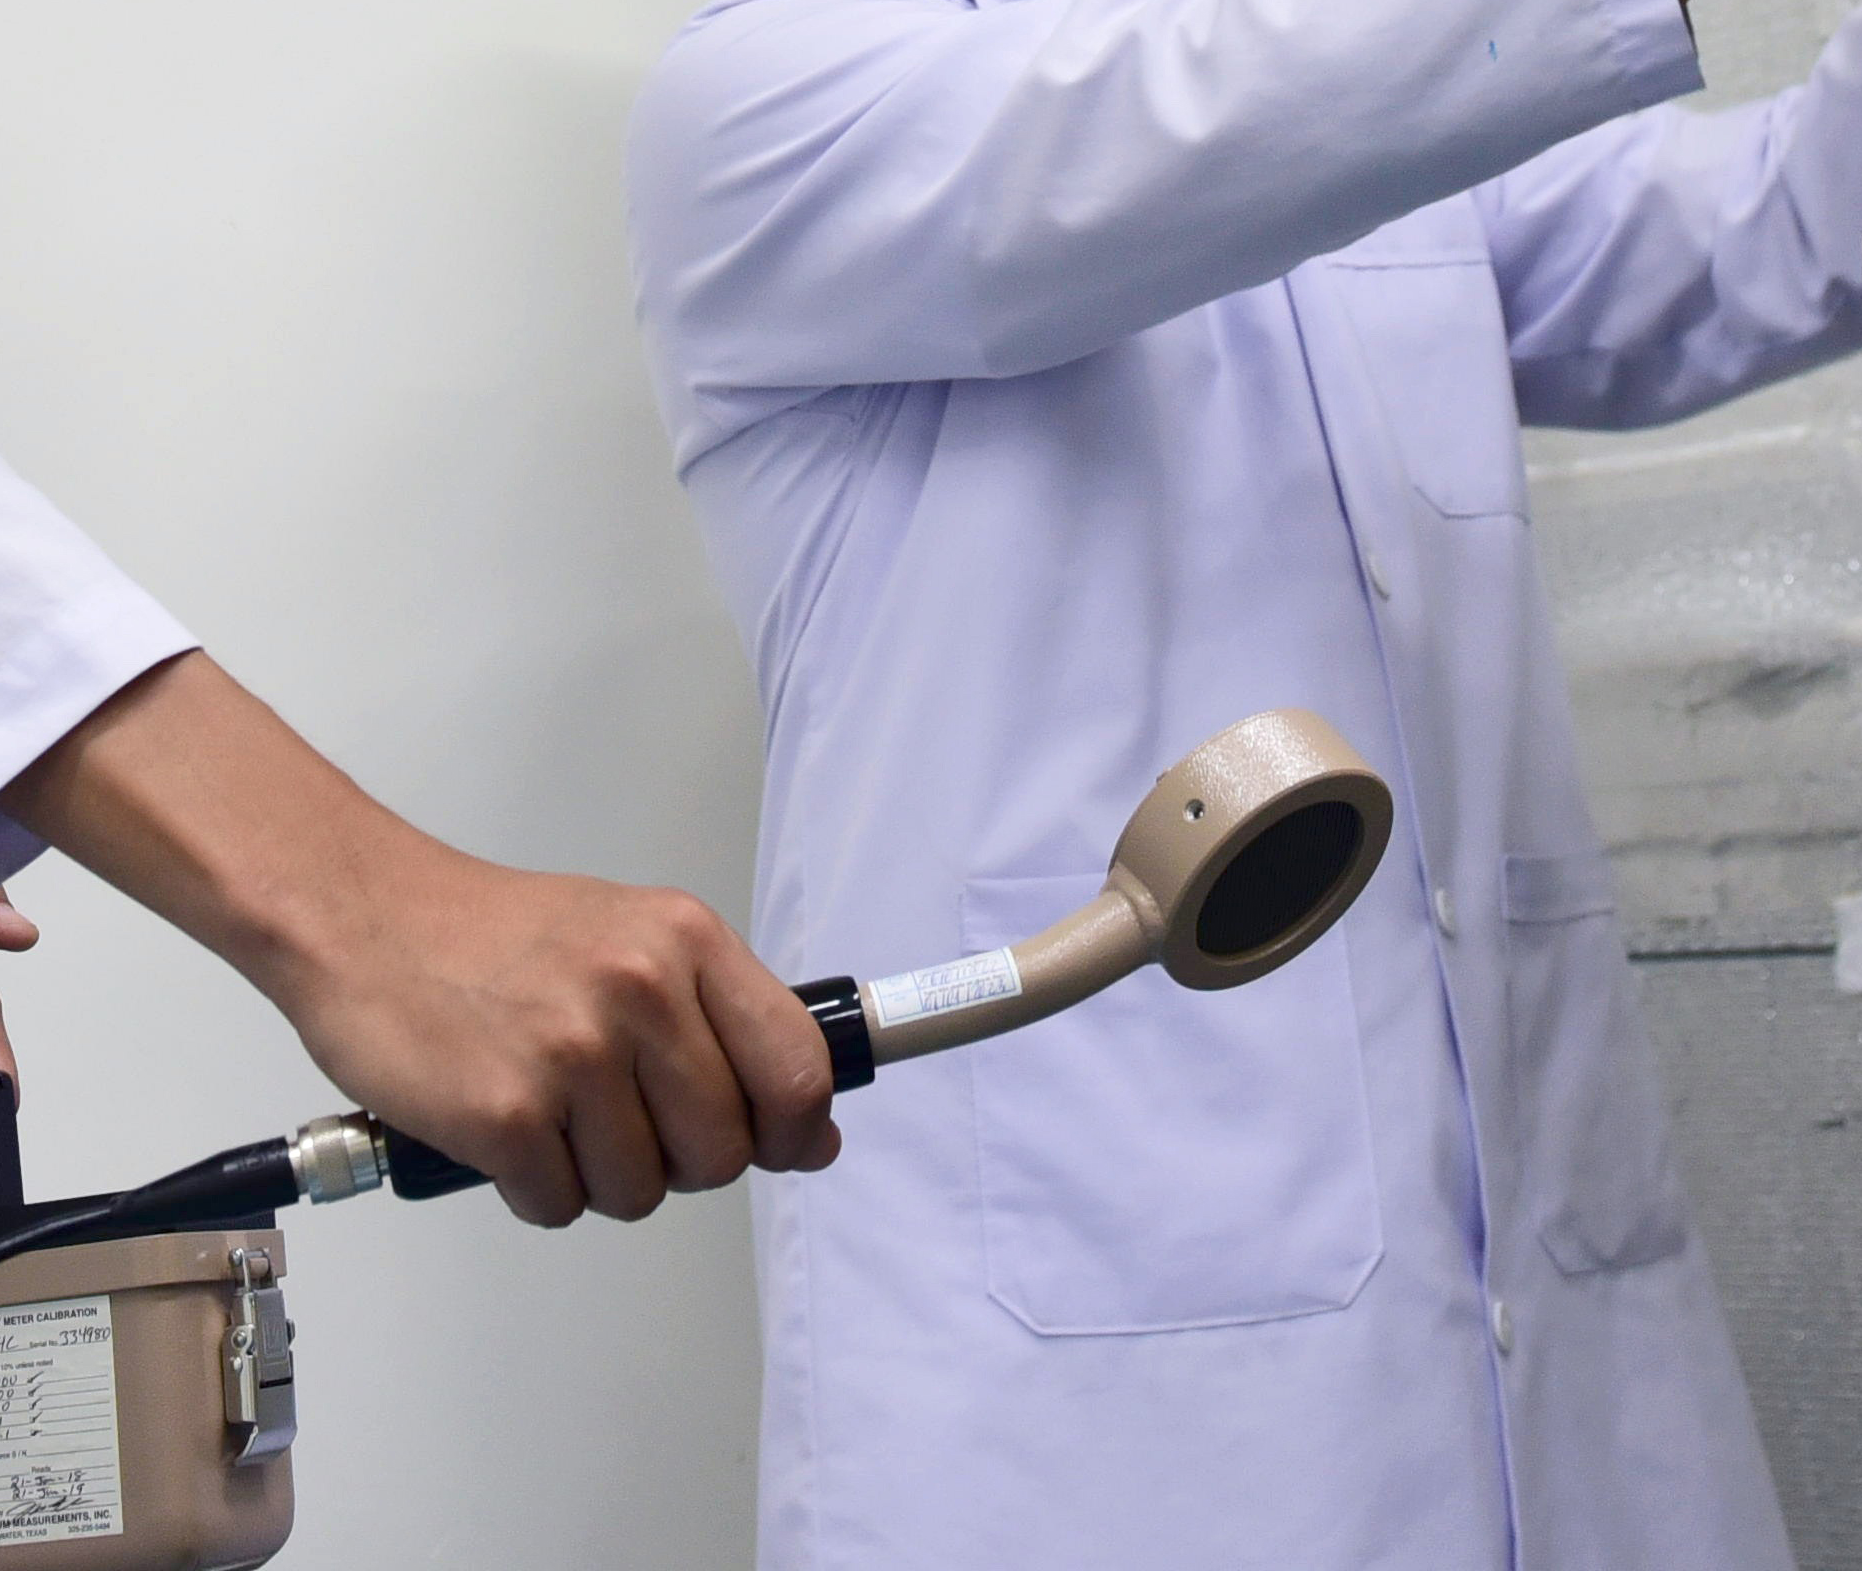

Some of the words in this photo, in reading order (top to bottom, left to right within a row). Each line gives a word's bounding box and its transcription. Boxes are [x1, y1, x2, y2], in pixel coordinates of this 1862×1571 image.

[4, 1314, 34, 1326] METER
[36, 1307, 98, 1322] CALIBRATION
[94, 1509, 112, 1520] INC.
[26, 1529, 48, 1538] TEXAS
